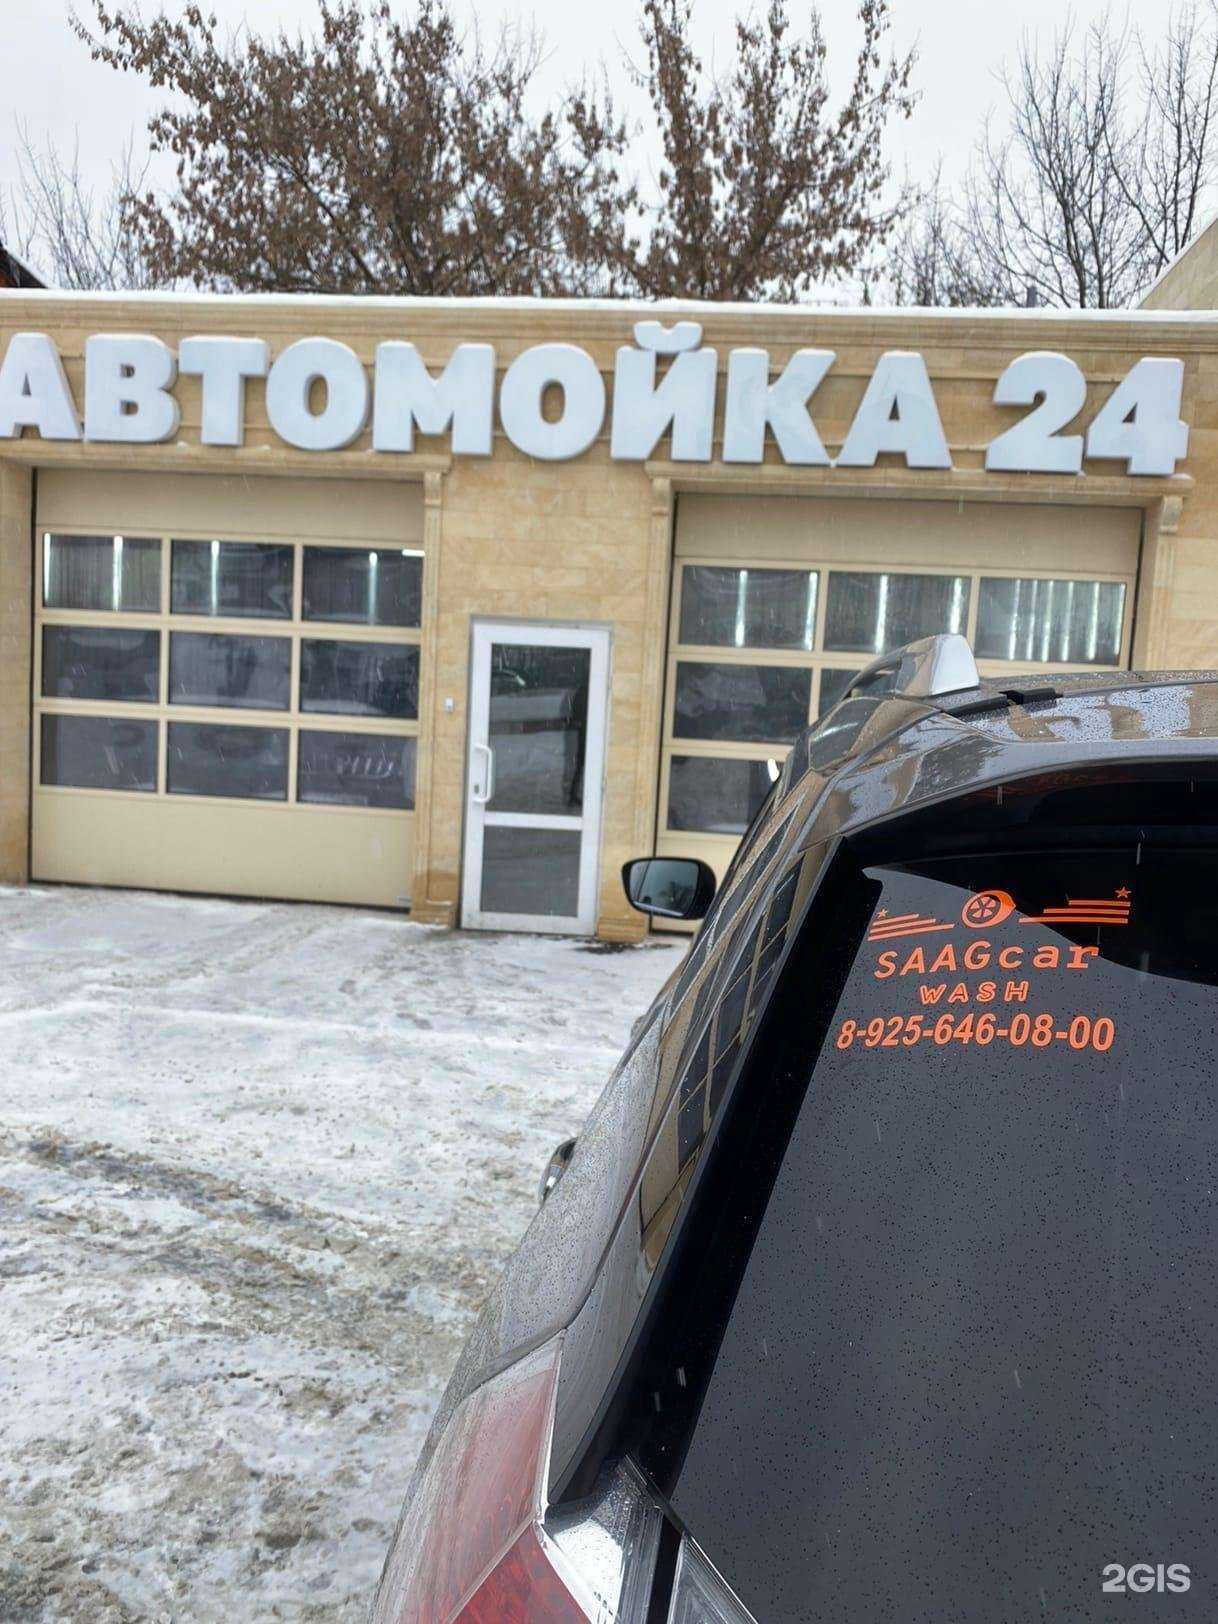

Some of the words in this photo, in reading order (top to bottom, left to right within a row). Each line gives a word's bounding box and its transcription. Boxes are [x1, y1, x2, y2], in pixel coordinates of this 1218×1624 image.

[0, 321, 953, 469] АВТОМОЙКА
[985, 351, 1190, 476] 24
[873, 940, 1100, 979] SAAGcar
[919, 980, 1030, 1005] WASH
[836, 1013, 1115, 1051] 8-925-646-08-00
